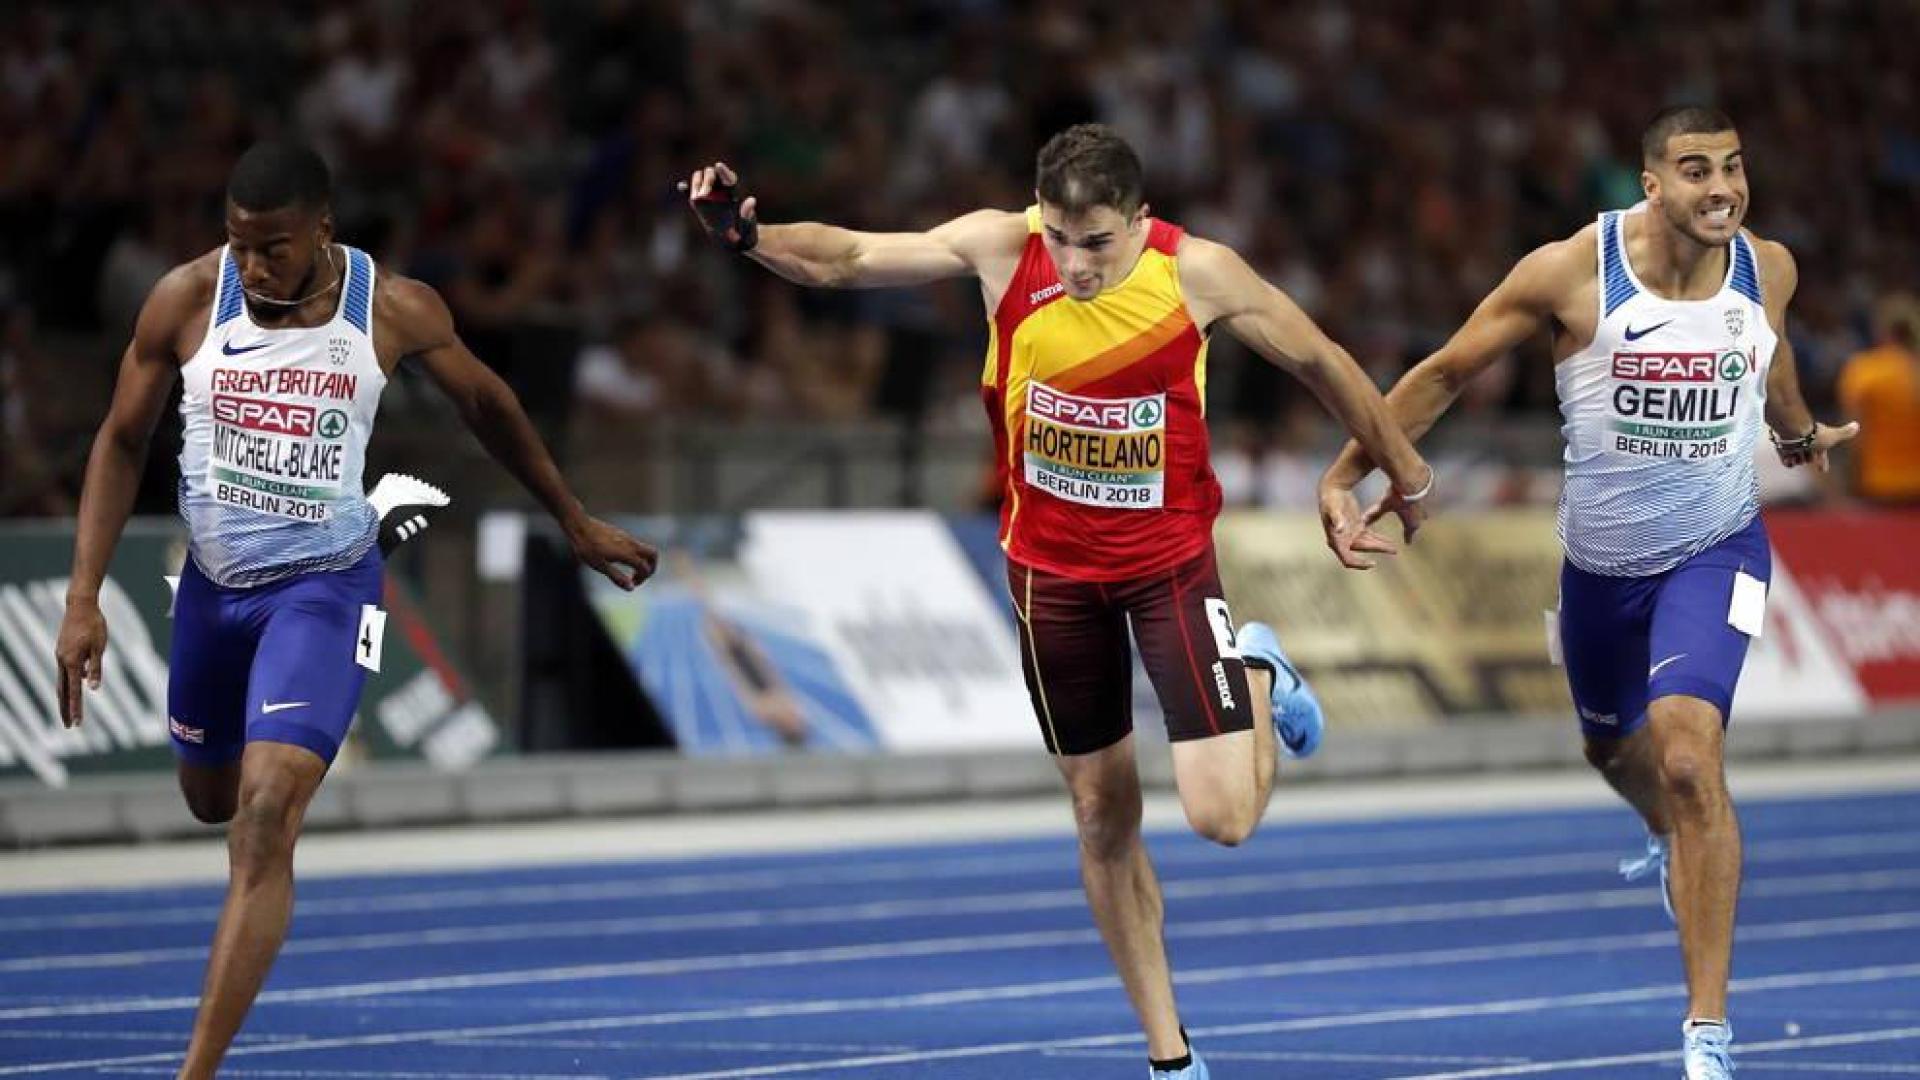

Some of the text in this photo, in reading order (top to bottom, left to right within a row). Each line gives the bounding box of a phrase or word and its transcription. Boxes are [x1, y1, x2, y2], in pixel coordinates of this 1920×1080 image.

[211, 368, 358, 401] GREAT BRITAIN
[1614, 357, 1714, 378] SPAR
[215, 398, 312, 432] SPAR
[1031, 388, 1126, 427] SPAR
[1613, 385, 1740, 422] GEMILI
[213, 424, 343, 481] MITCHELL-BLAKE
[1029, 421, 1160, 469] HORTELANO
[1616, 436, 1728, 459] BERLIN 2018
[216, 485, 326, 521] BERLIN 2018
[1036, 470, 1151, 503] BERLIN 2018
[360, 623, 372, 658] 4
